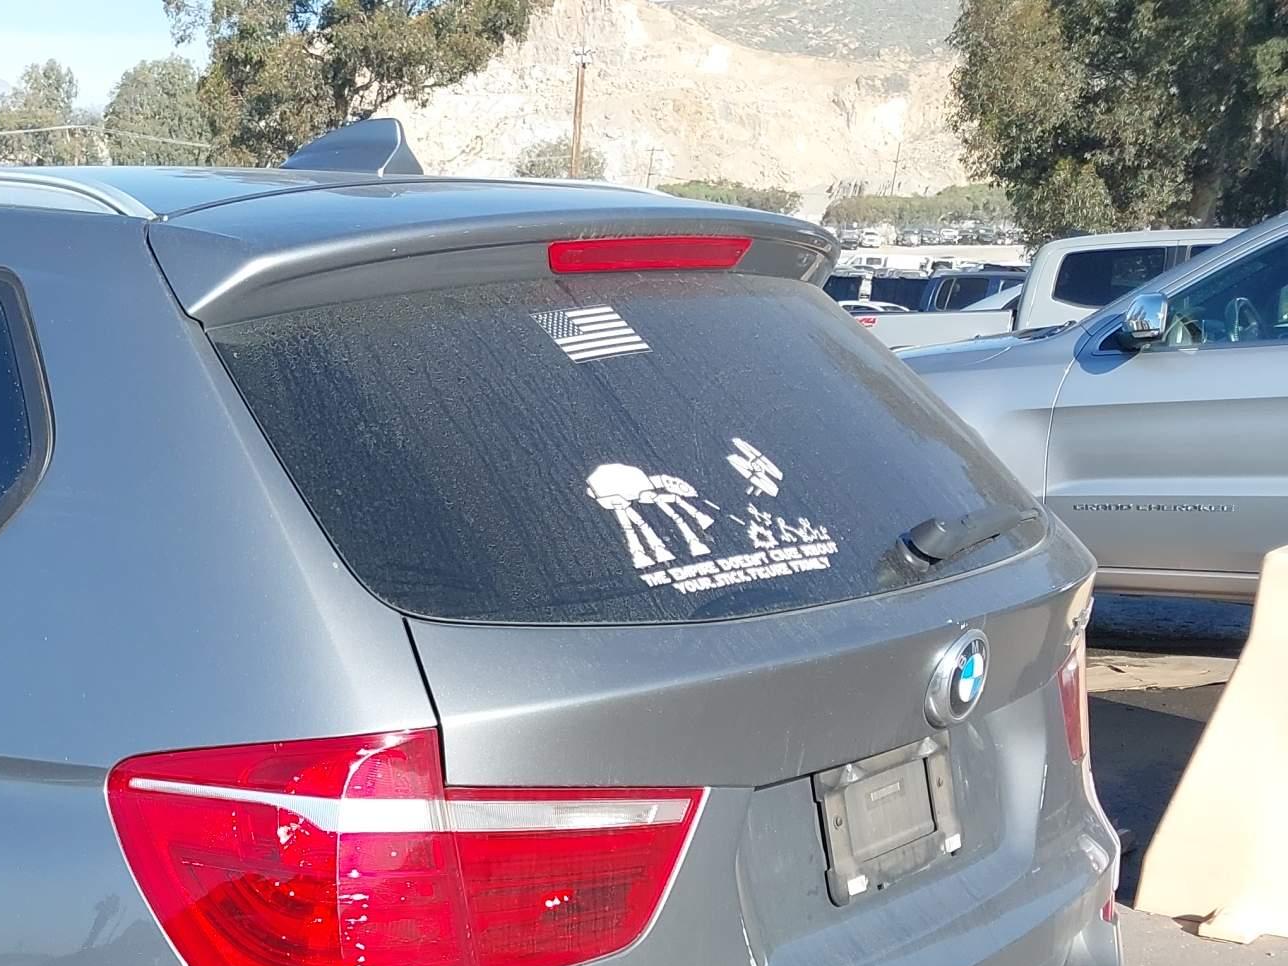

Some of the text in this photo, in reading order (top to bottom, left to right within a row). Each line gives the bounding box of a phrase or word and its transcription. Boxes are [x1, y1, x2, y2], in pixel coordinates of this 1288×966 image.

[1073, 503, 1240, 513] GRAND CHEROKEE
[639, 571, 672, 588] THE
[668, 561, 720, 582] EMPIRE
[768, 546, 802, 562] CARE
[799, 541, 839, 557] ABOUT
[672, 577, 717, 595] YOUR
[712, 570, 752, 588] STICK
[746, 562, 793, 581] FIGURE
